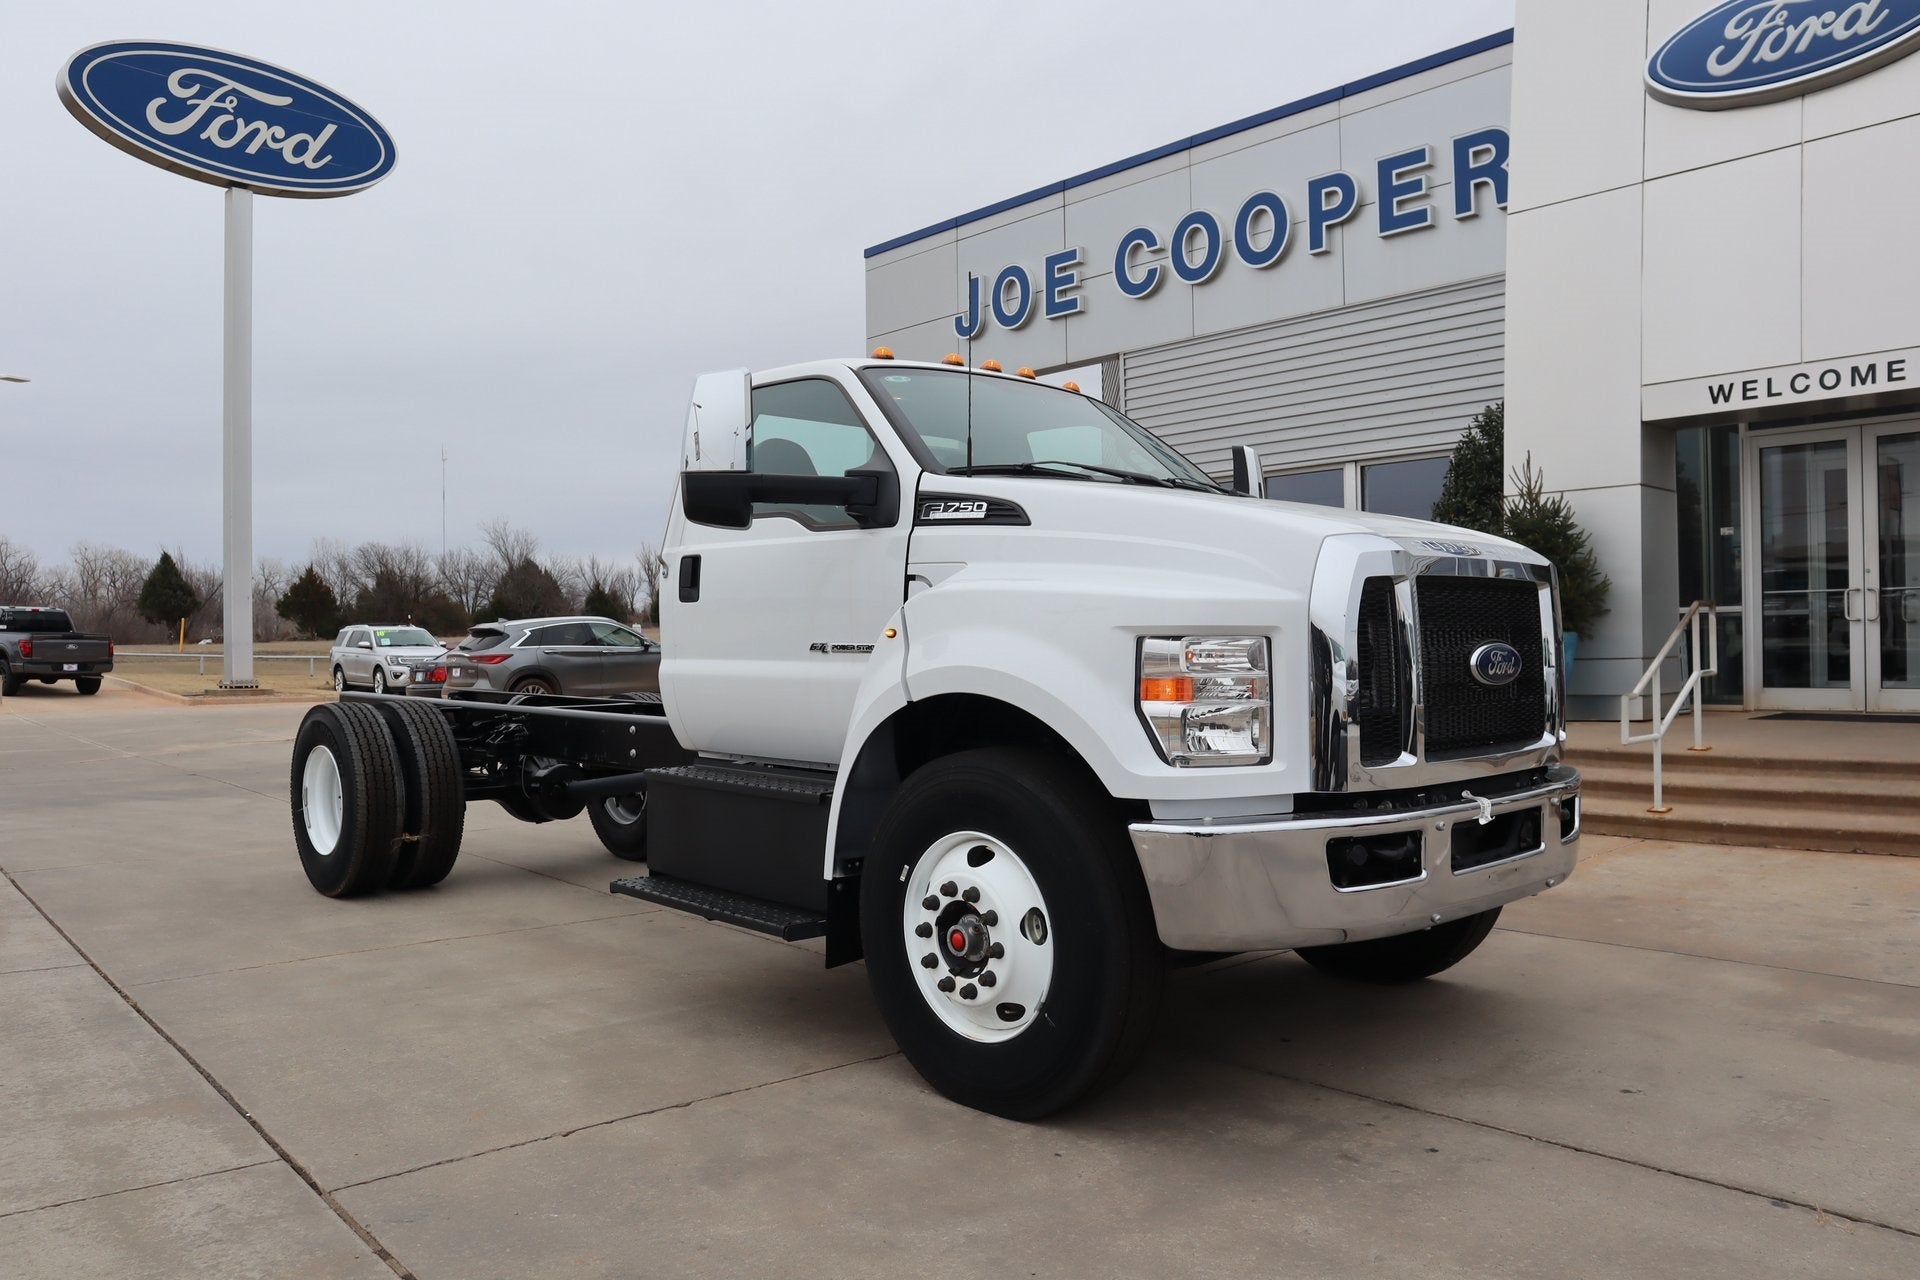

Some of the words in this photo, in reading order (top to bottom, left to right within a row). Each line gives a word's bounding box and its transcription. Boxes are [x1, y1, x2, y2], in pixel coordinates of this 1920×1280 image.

[1706, 0, 1890, 77] Ford
[146, 67, 339, 170] Ford
[953, 246, 1085, 340] JOE
[1113, 125, 1510, 300] COOPER
[1707, 358, 1907, 405] WELCOME
[1488, 650, 1515, 675] Ford
